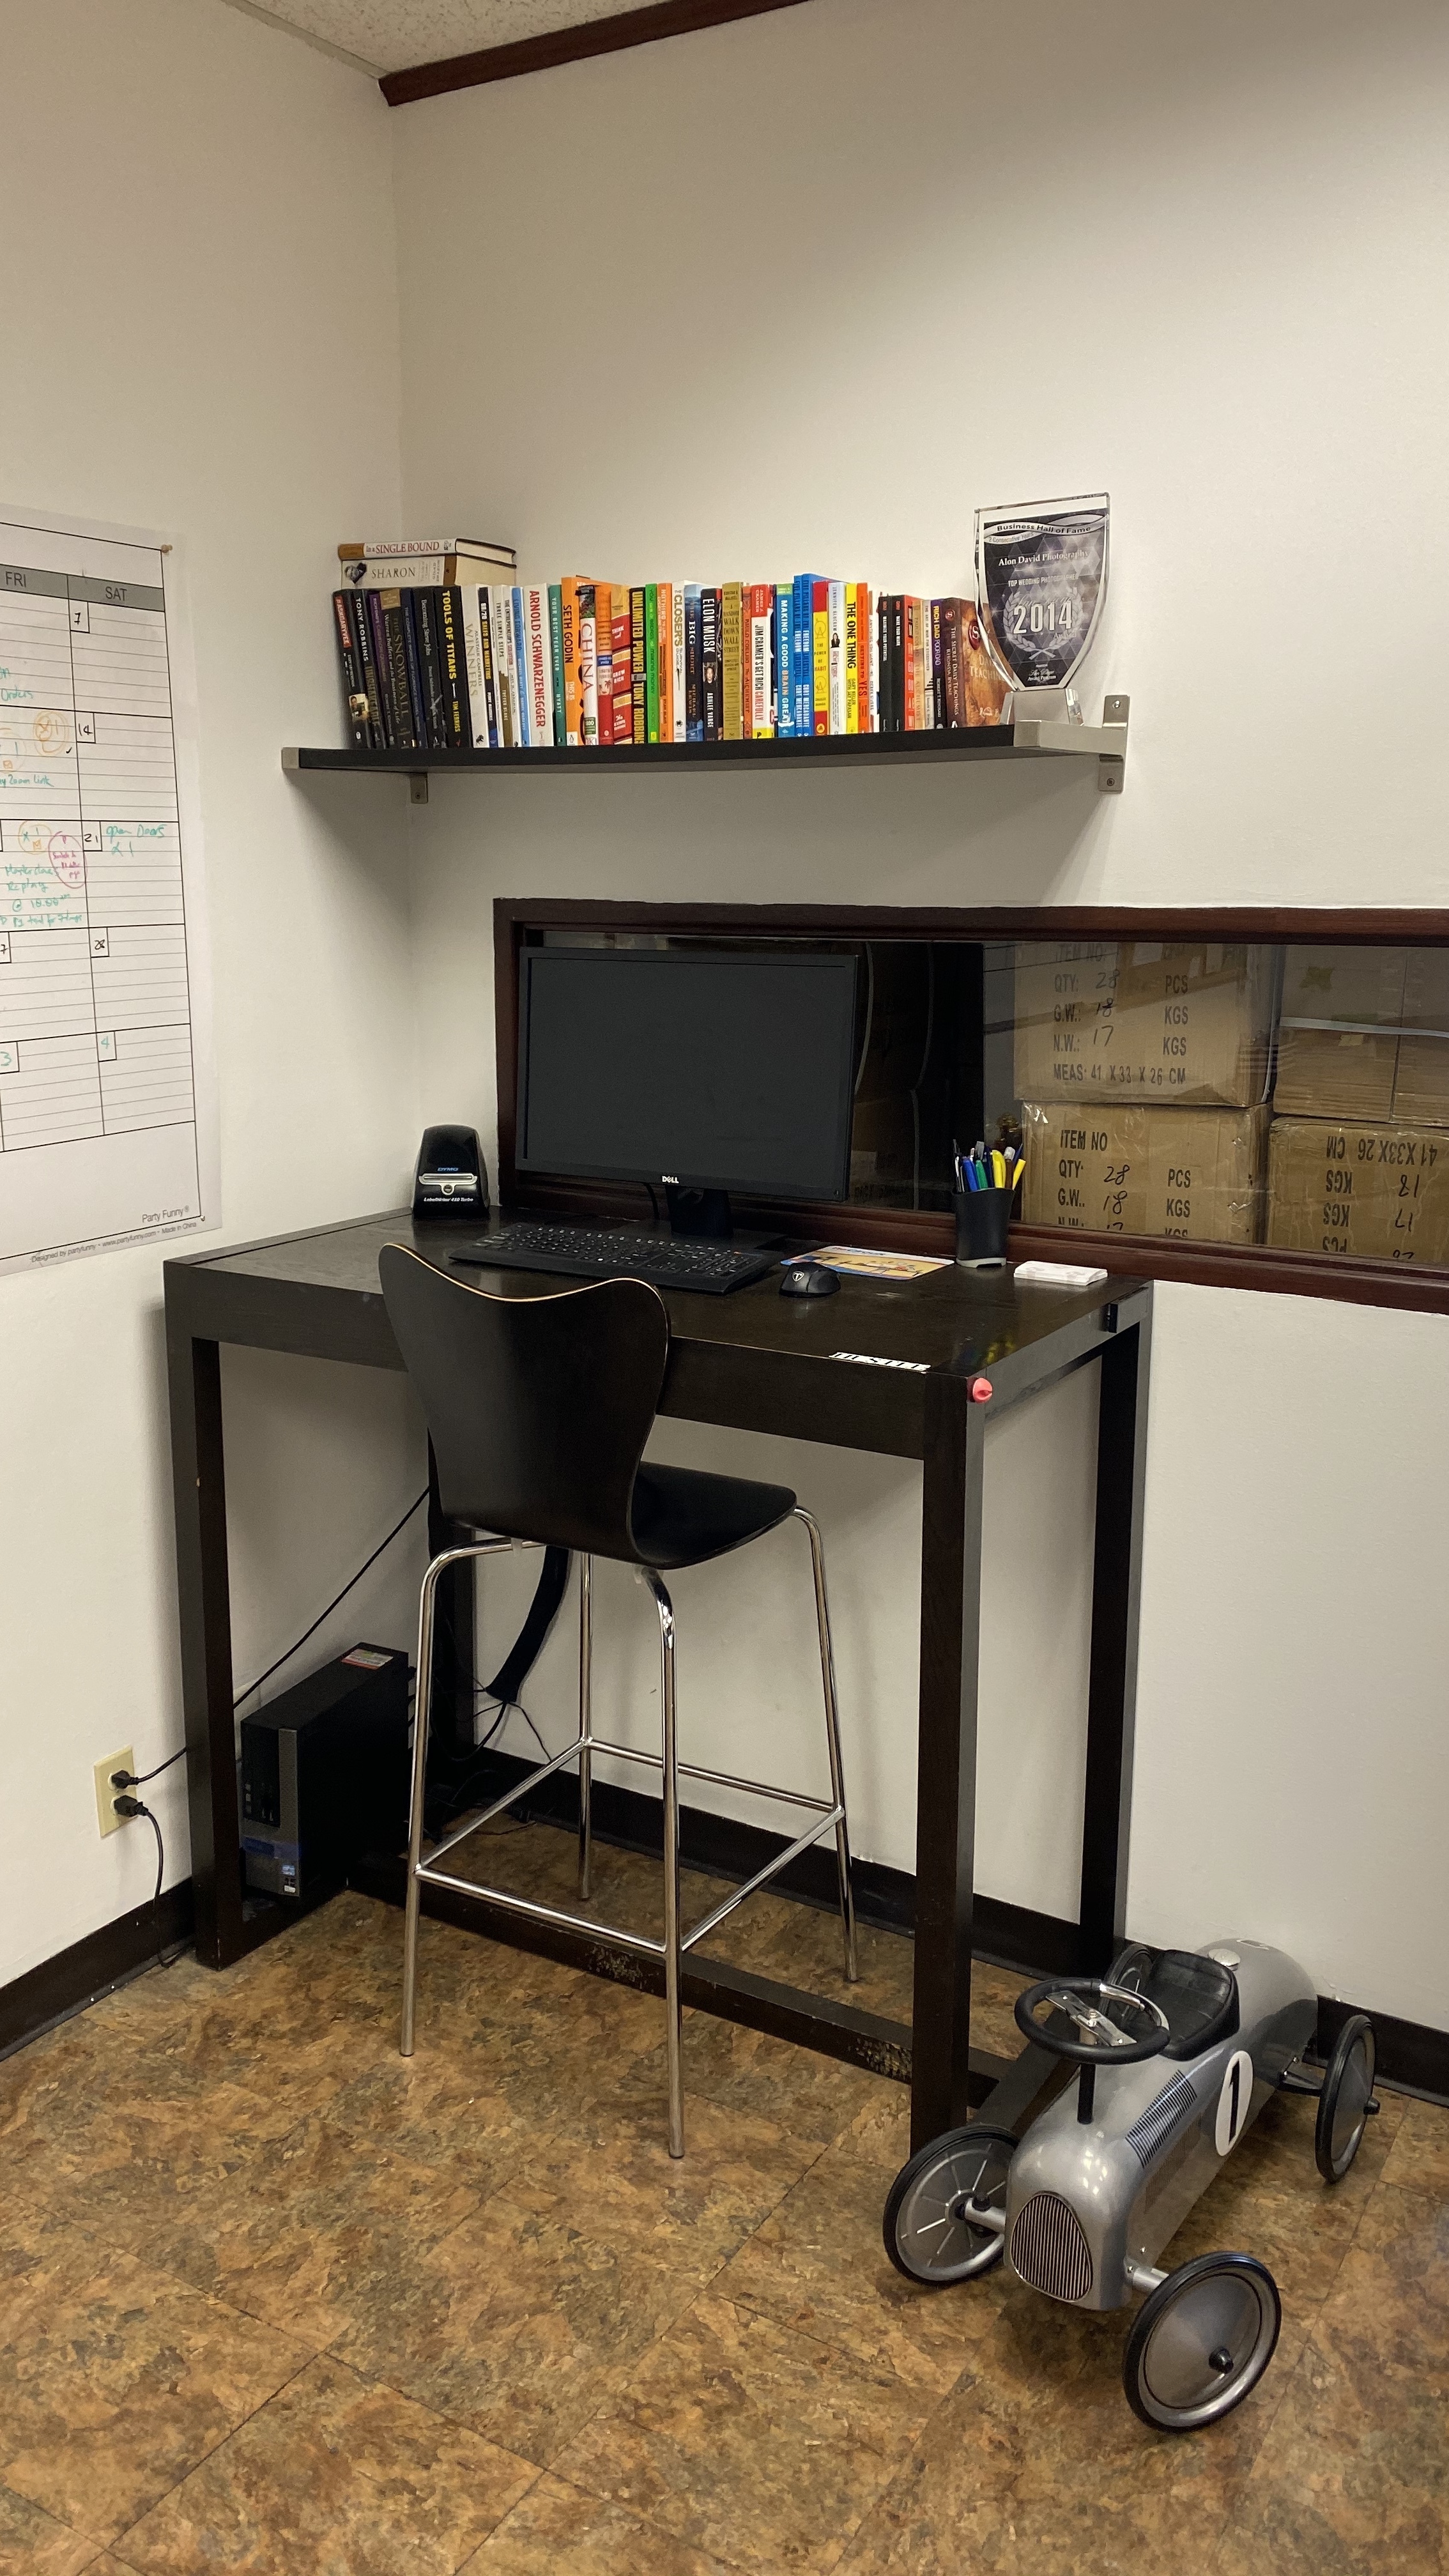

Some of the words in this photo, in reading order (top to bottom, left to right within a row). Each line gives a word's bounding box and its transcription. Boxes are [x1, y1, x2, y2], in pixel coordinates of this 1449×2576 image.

[997, 523, 1034, 532] Business
[1036, 524, 1054, 533] Hall
[1055, 526, 1064, 534] of
[1066, 526, 1092, 535] Fame
[376, 543, 406, 555] SINGLE
[407, 541, 440, 553] BOUND
[998, 556, 1017, 567] Alon
[1018, 553, 1041, 564] David
[1043, 549, 1089, 563] Photography
[5, 571, 26, 588] FRI
[371, 567, 417, 579] SHARON
[105, 586, 127, 602] SAT
[356, 597, 364, 621] TONY
[420, 599, 429, 628] Becoming
[441, 590, 453, 625] TOOLS
[529, 590, 542, 632] ARNOLD
[562, 604, 573, 630] SETH
[632, 590, 644, 638] UNLIMITED
[702, 598, 715, 623] ELON
[780, 599, 788, 634] MAKING
[847, 601, 856, 619] THE
[933, 605, 941, 623] RICH
[1013, 601, 1073, 634] 2014
[673, 594, 684, 647] CLOSER'S
[688, 620, 696, 645] BIG
[723, 617, 740, 626] WALK
[723, 627, 740, 636] DOWN
[755, 624, 764, 636] JIM
[847, 620, 856, 640] ONE
[359, 624, 369, 662] ROBBINS
[445, 626, 454, 641] OF
[702, 624, 716, 654] MUSK
[723, 636, 740, 645] WALL
[564, 631, 574, 664] GODIN
[581, 622, 595, 693] CHINA
[632, 640, 644, 672] POWER
[723, 645, 740, 654] STREET
[755, 637, 764, 666] CRAMER'S
[781, 643, 789, 668] GOOD
[847, 640, 857, 669] THING
[446, 642, 457, 680] TITANS
[464, 623, 479, 697] WINNERS
[755, 666, 764, 677] GET
[394, 633, 410, 717] SNOWBALL
[532, 633, 546, 728] SCHWARZENEGGER
[755, 677, 765, 691] RICH
[781, 669, 790, 696] BRAIN
[860, 670, 865, 679] TO
[633, 681, 644, 705] TONY
[858, 680, 868, 696] YES
[755, 691, 765, 721] CAREFULLY
[781, 697, 790, 723] GREAT
[453, 710, 461, 733] FERRISS
[84, 832, 98, 844] 21
[1054, 974, 1079, 993] QTY:
[1165, 975, 1188, 994] PCS
[1165, 1006, 1189, 1025] KGS
[100, 1036, 111, 1050] 4
[1093, 1025, 1114, 1047] 17
[1163, 1036, 1187, 1056] KGS
[1091, 1064, 1101, 1081] 41
[1150, 1068, 1163, 1085] 26
[1169, 1068, 1186, 1085] CM
[1059, 1129, 1086, 1150] ITEM
[1091, 1131, 1108, 1152] NO
[1326, 1135, 1346, 1160] CM
[1357, 1138, 1376, 1162] 26
[1420, 1143, 1438, 1167] 41
[661, 1175, 680, 1184] DELL
[1103, 1164, 1130, 1186] 28
[1167, 1169, 1191, 1188] PCS
[1325, 1169, 1353, 1194] KGS
[1397, 1174, 1420, 1199] 18
[142, 1213, 161, 1223] Party
[162, 1209, 184, 1218] Funny
[1102, 1190, 1128, 1215] 18
[1166, 1199, 1190, 1218] KGS
[1322, 1202, 1351, 1228] KGS
[1394, 1208, 1412, 1233] 17
[32, 1250, 59, 1263] Designed
[59, 1248, 68, 1258] by
[1227, 2058, 1241, 2147] 1
